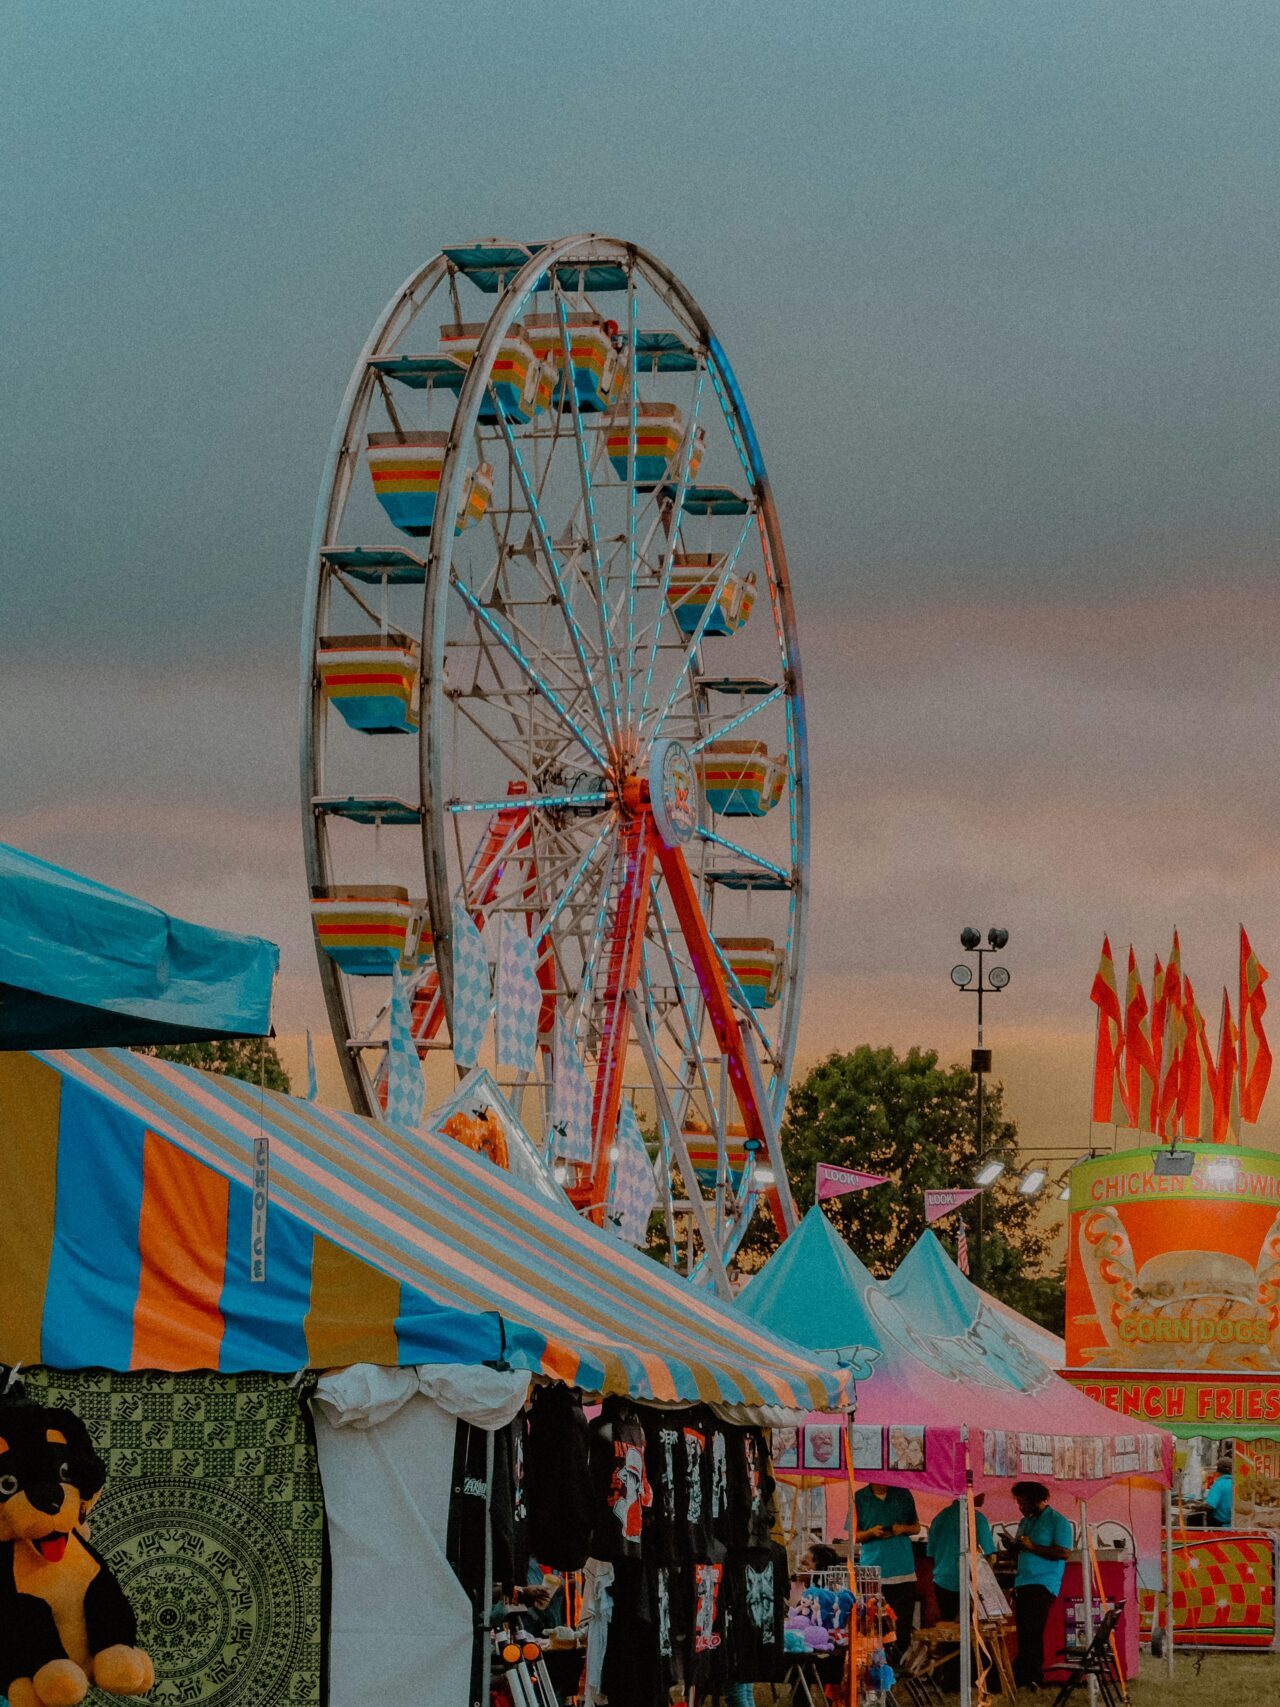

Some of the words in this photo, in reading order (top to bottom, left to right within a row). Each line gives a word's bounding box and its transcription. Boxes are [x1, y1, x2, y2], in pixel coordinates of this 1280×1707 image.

[823, 1167, 860, 1186] LOOK!
[1090, 1171, 1185, 1202] CHICKEN
[252, 1145, 267, 1279] CHOICE
[927, 1193, 957, 1206] LOOK!
[1119, 1318, 1192, 1344] CORN
[1198, 1318, 1270, 1344] DOGS
[1076, 1384, 1185, 1419] RENCH
